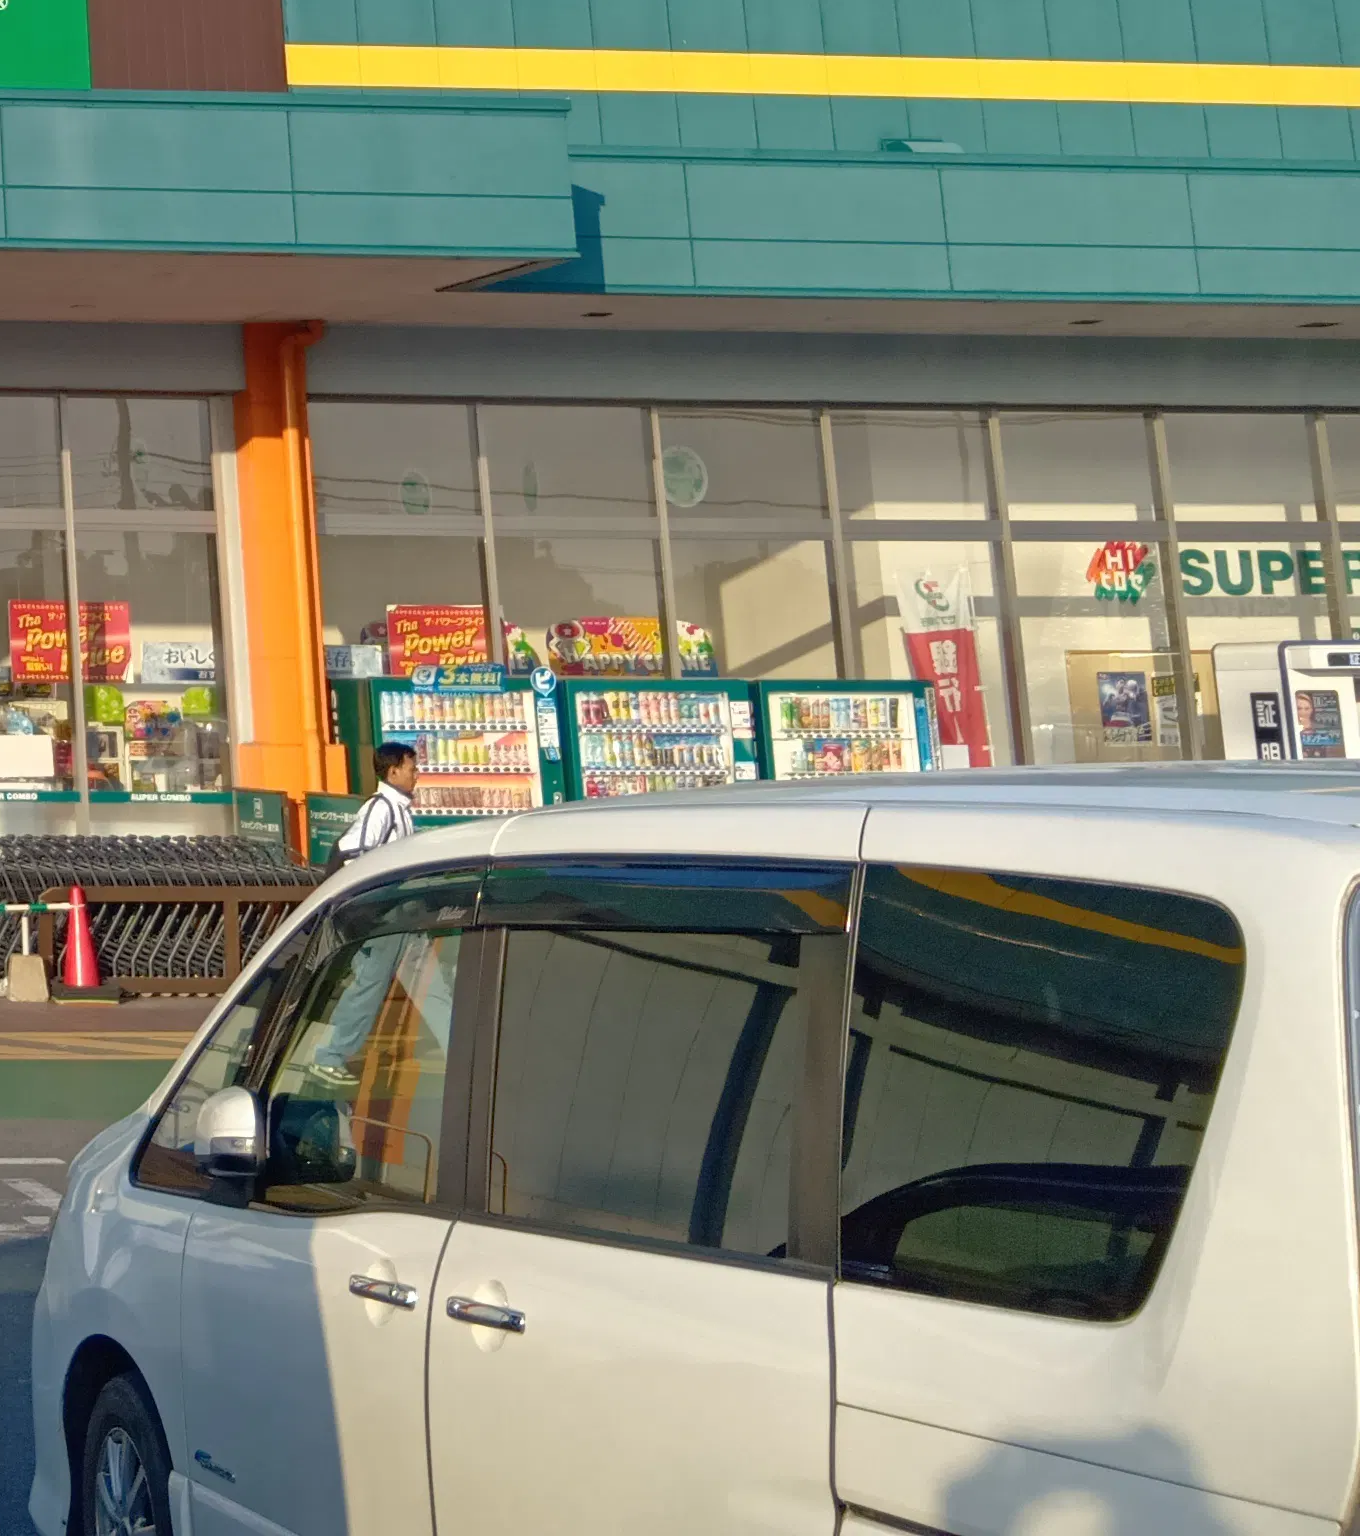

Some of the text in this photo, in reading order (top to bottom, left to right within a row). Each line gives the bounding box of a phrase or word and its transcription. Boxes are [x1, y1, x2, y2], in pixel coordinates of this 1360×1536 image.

[18, 613, 42, 629] The
[395, 618, 419, 634] The
[404, 628, 479, 657] Power
[563, 647, 639, 672] HAPPY
[6, 792, 38, 801] COMBO
[131, 793, 192, 802] SUPER COMBO
